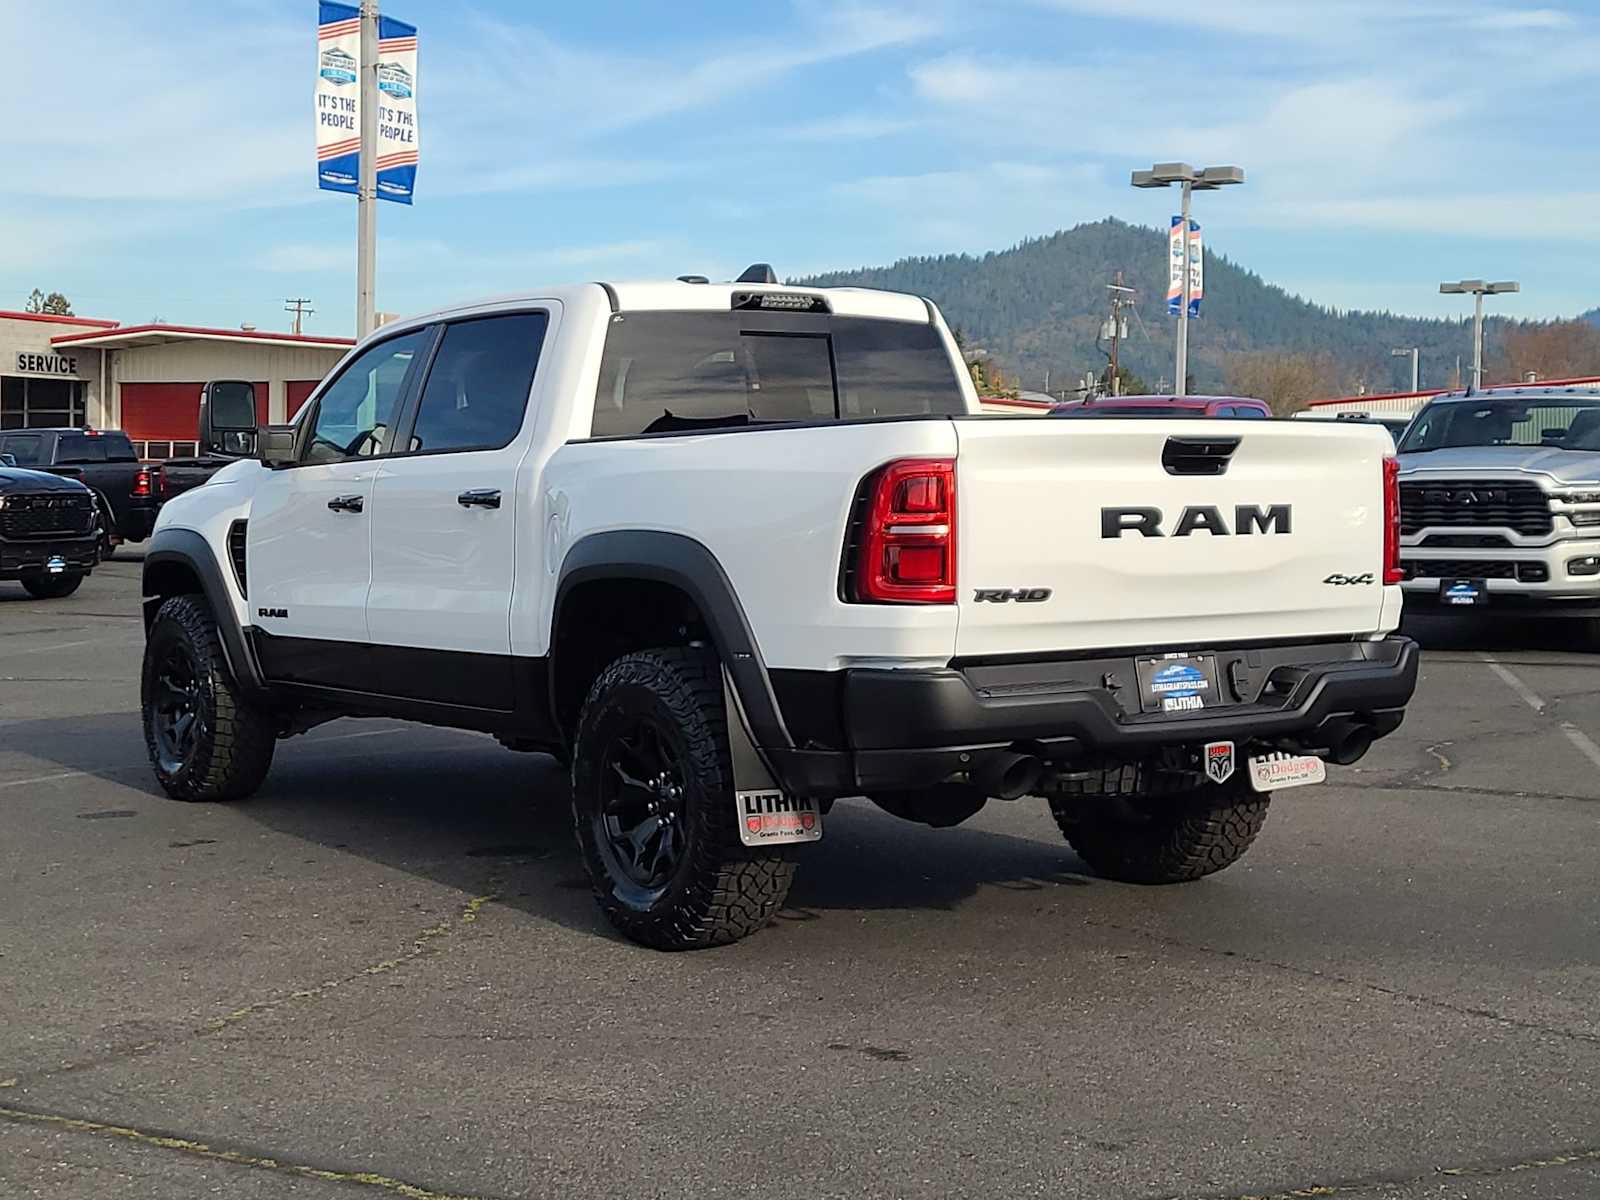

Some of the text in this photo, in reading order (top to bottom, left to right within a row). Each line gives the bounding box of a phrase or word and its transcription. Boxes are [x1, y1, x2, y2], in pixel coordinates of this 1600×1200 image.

[318, 94, 356, 113] IT'S THE
[321, 112, 354, 130] PEOPLE
[379, 106, 413, 126] IT'S THE
[380, 124, 413, 143] PEOPLE
[18, 354, 77, 374] SERVICE
[1101, 504, 1292, 538] RAM
[258, 607, 289, 618] RAM
[744, 794, 815, 814] LITHIA
